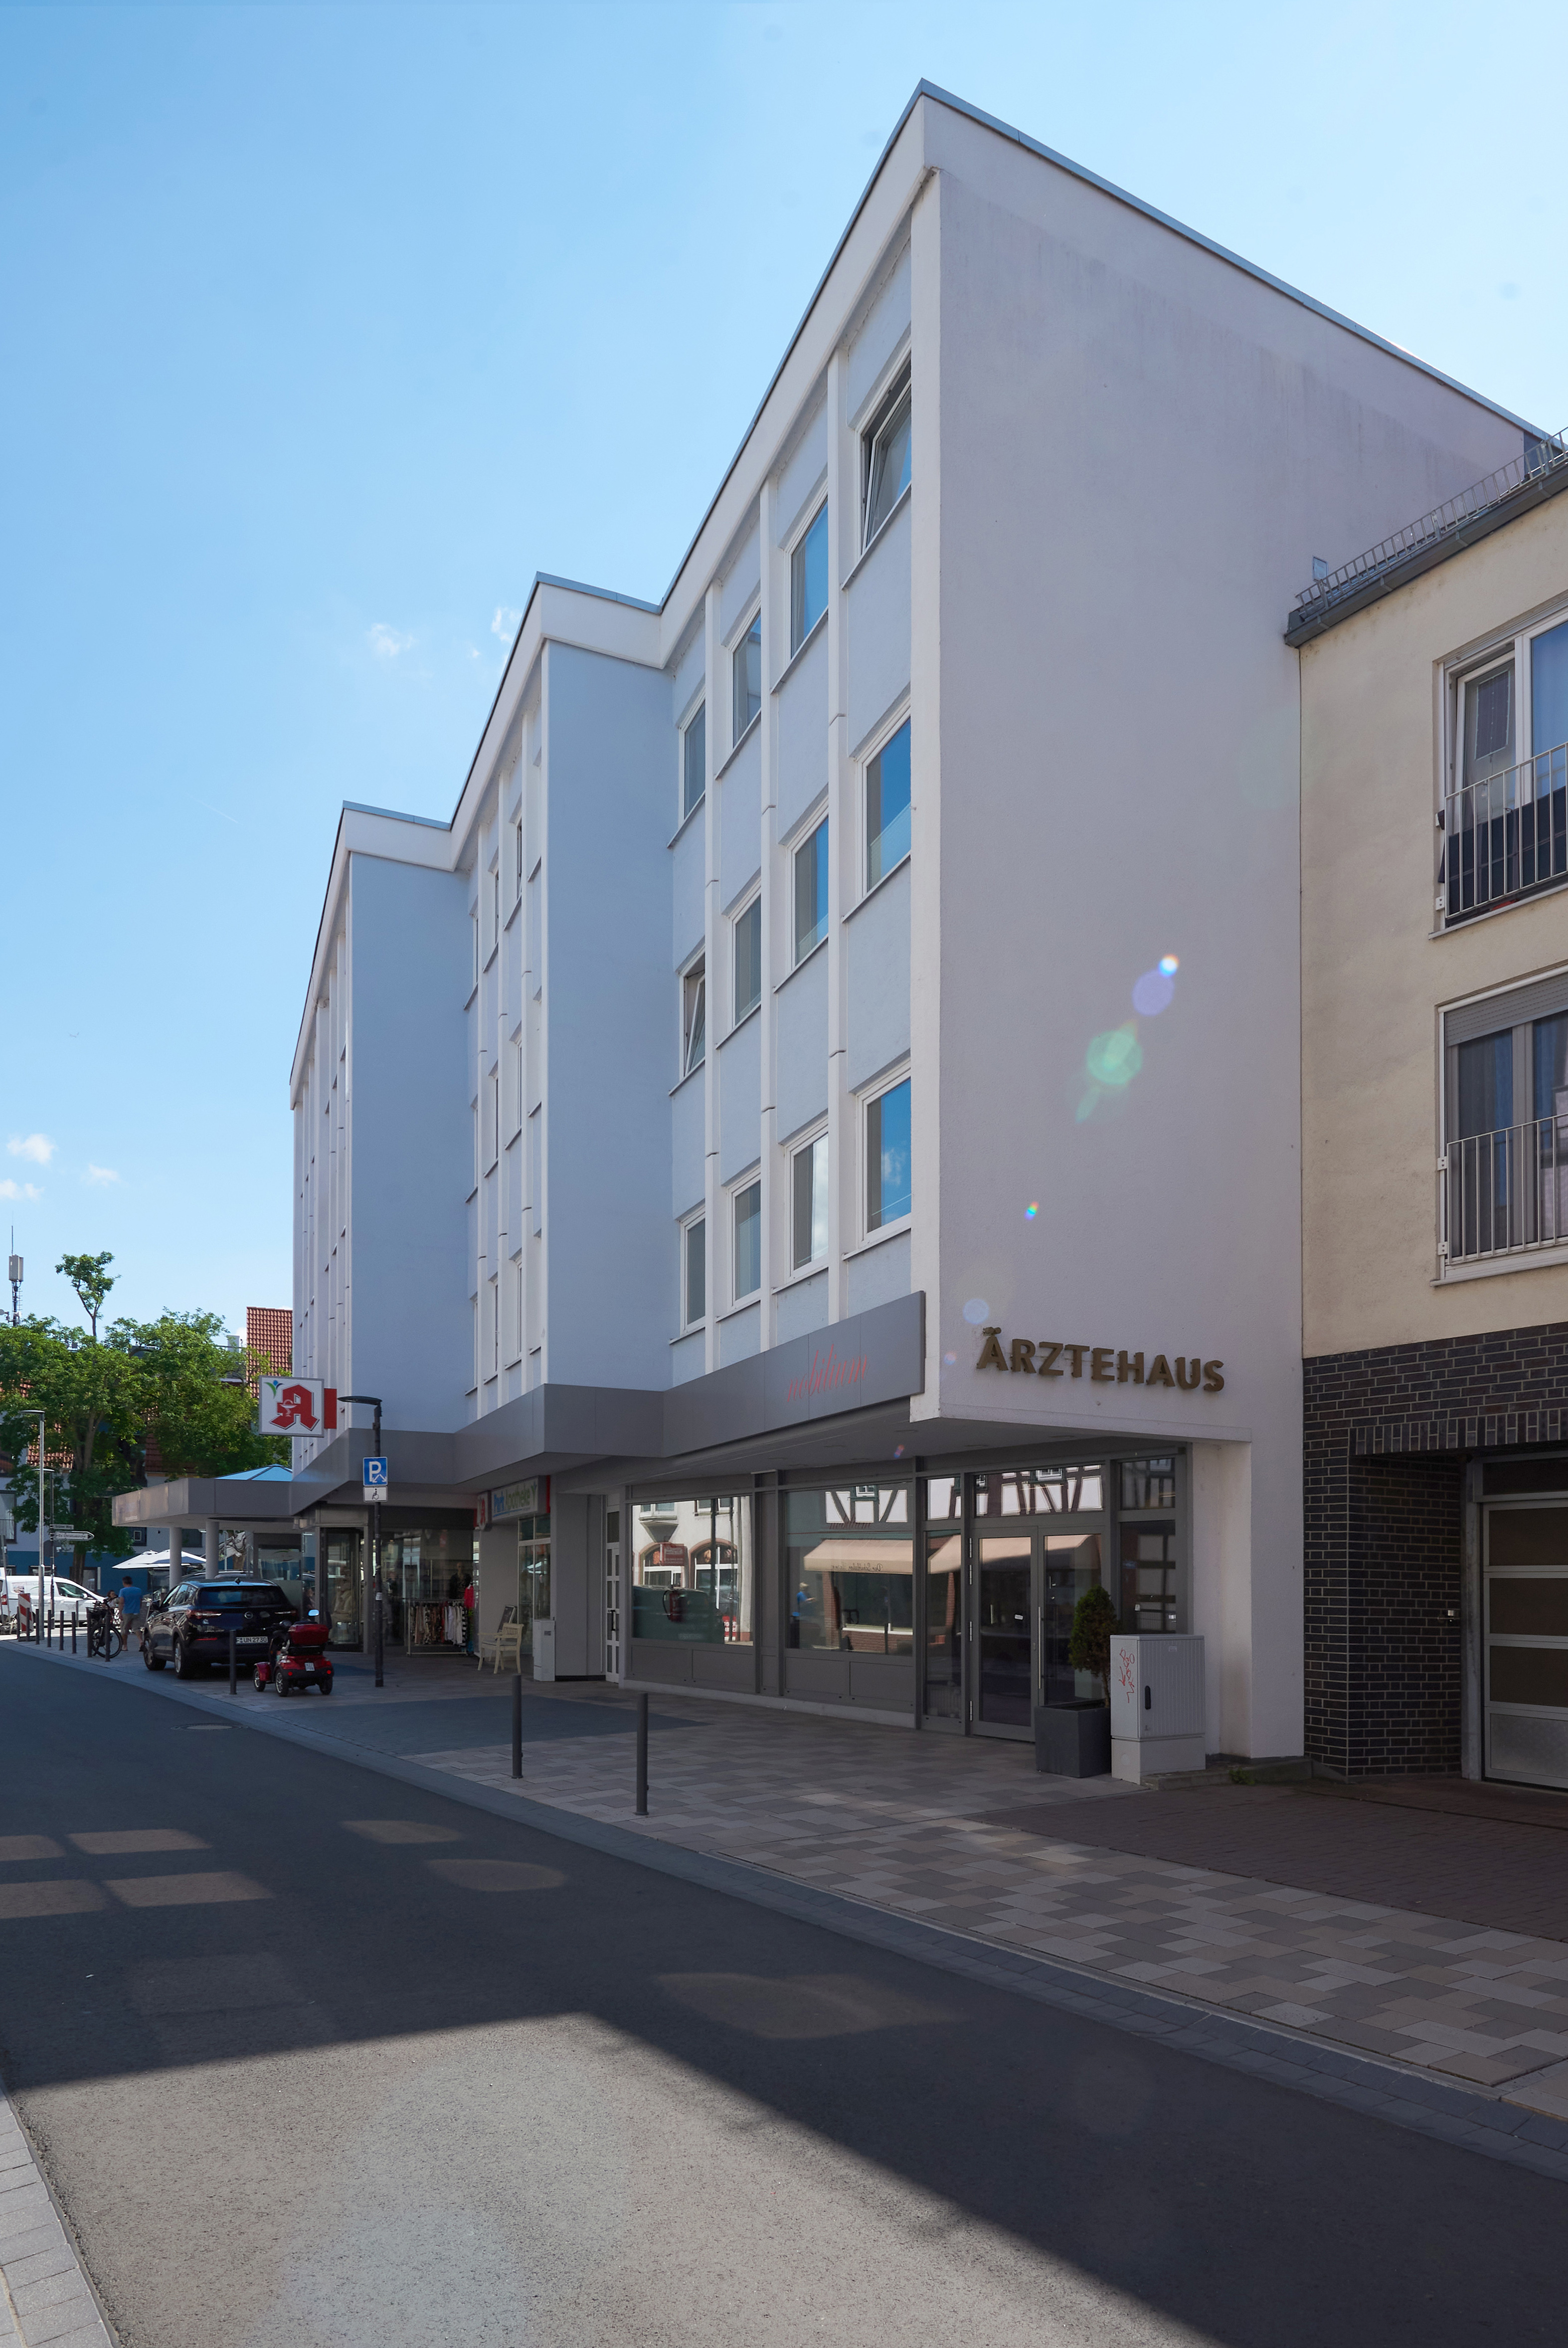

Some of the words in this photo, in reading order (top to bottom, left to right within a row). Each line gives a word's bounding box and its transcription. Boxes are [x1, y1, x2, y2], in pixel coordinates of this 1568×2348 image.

[787, 1344, 869, 1402] nobilium
[976, 1327, 1224, 1392] ÄRZTEHAUS
[269, 1383, 320, 1431] A
[369, 1461, 381, 1482] P
